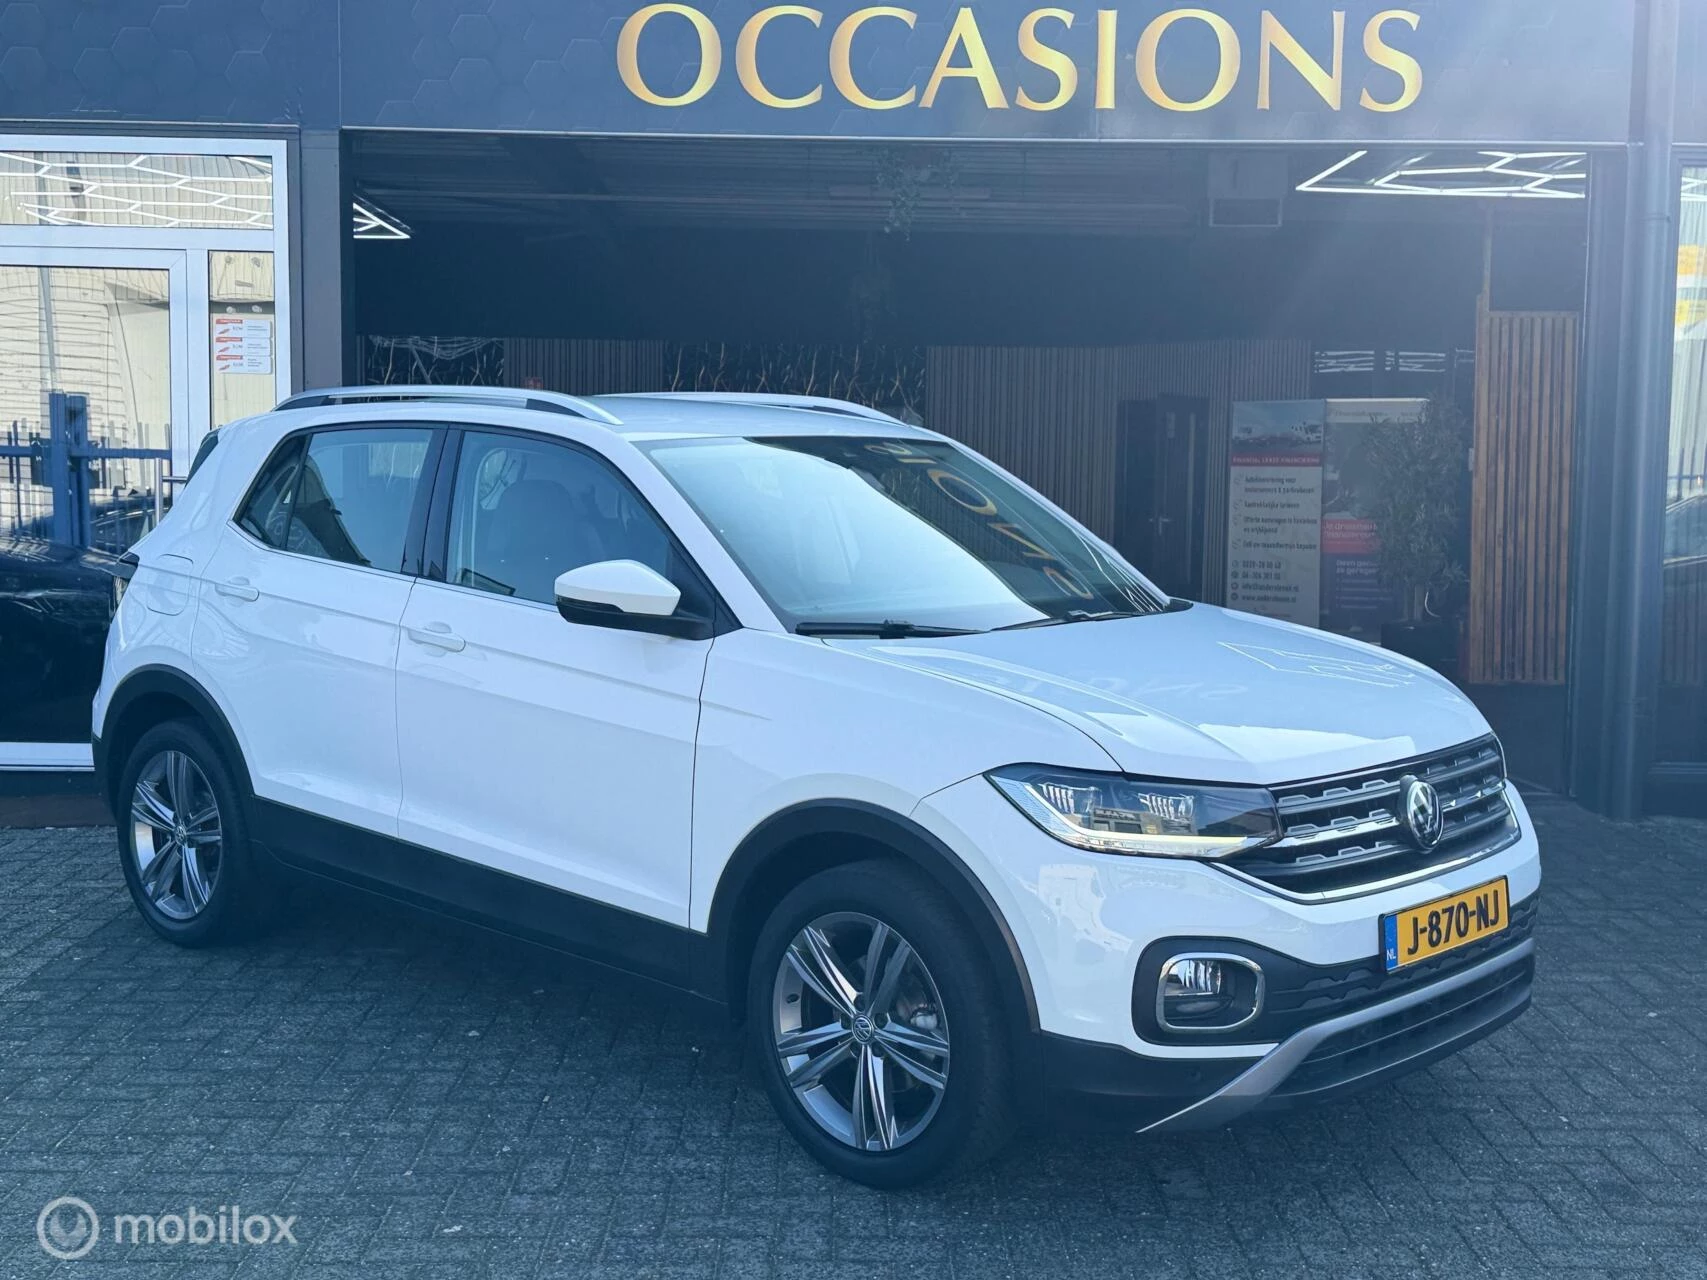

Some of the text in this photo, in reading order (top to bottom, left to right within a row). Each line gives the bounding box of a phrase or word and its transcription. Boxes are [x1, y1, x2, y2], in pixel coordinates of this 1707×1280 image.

[616, 3, 1424, 112] OCCASIONS
[1386, 948, 1397, 961] NL
[1407, 889, 1500, 955] J-870-NJ
